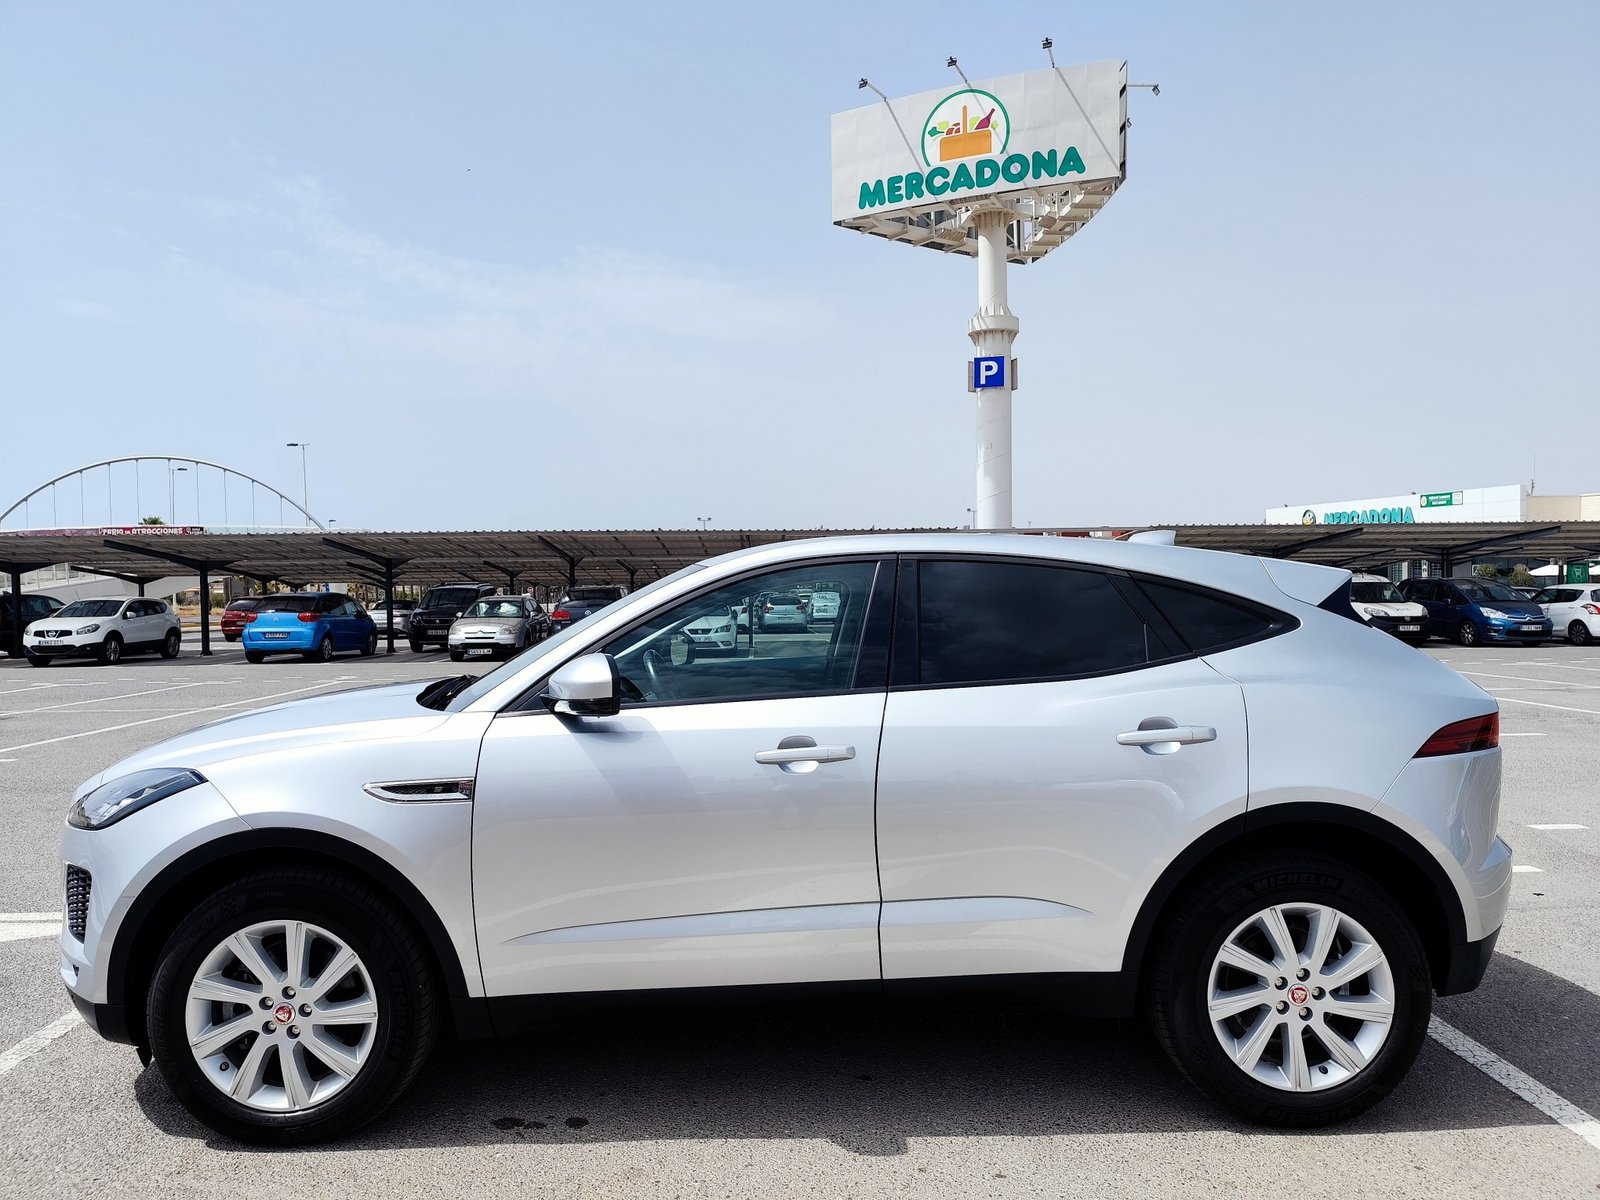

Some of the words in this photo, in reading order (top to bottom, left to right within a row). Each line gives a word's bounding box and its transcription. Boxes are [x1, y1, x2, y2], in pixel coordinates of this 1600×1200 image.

[858, 146, 1086, 209] MERCADONA
[980, 361, 998, 384] P
[1324, 506, 1415, 524] MERCADONA
[131, 527, 183, 536] ATRACCIONES
[1253, 873, 1339, 892] MICHELIN
